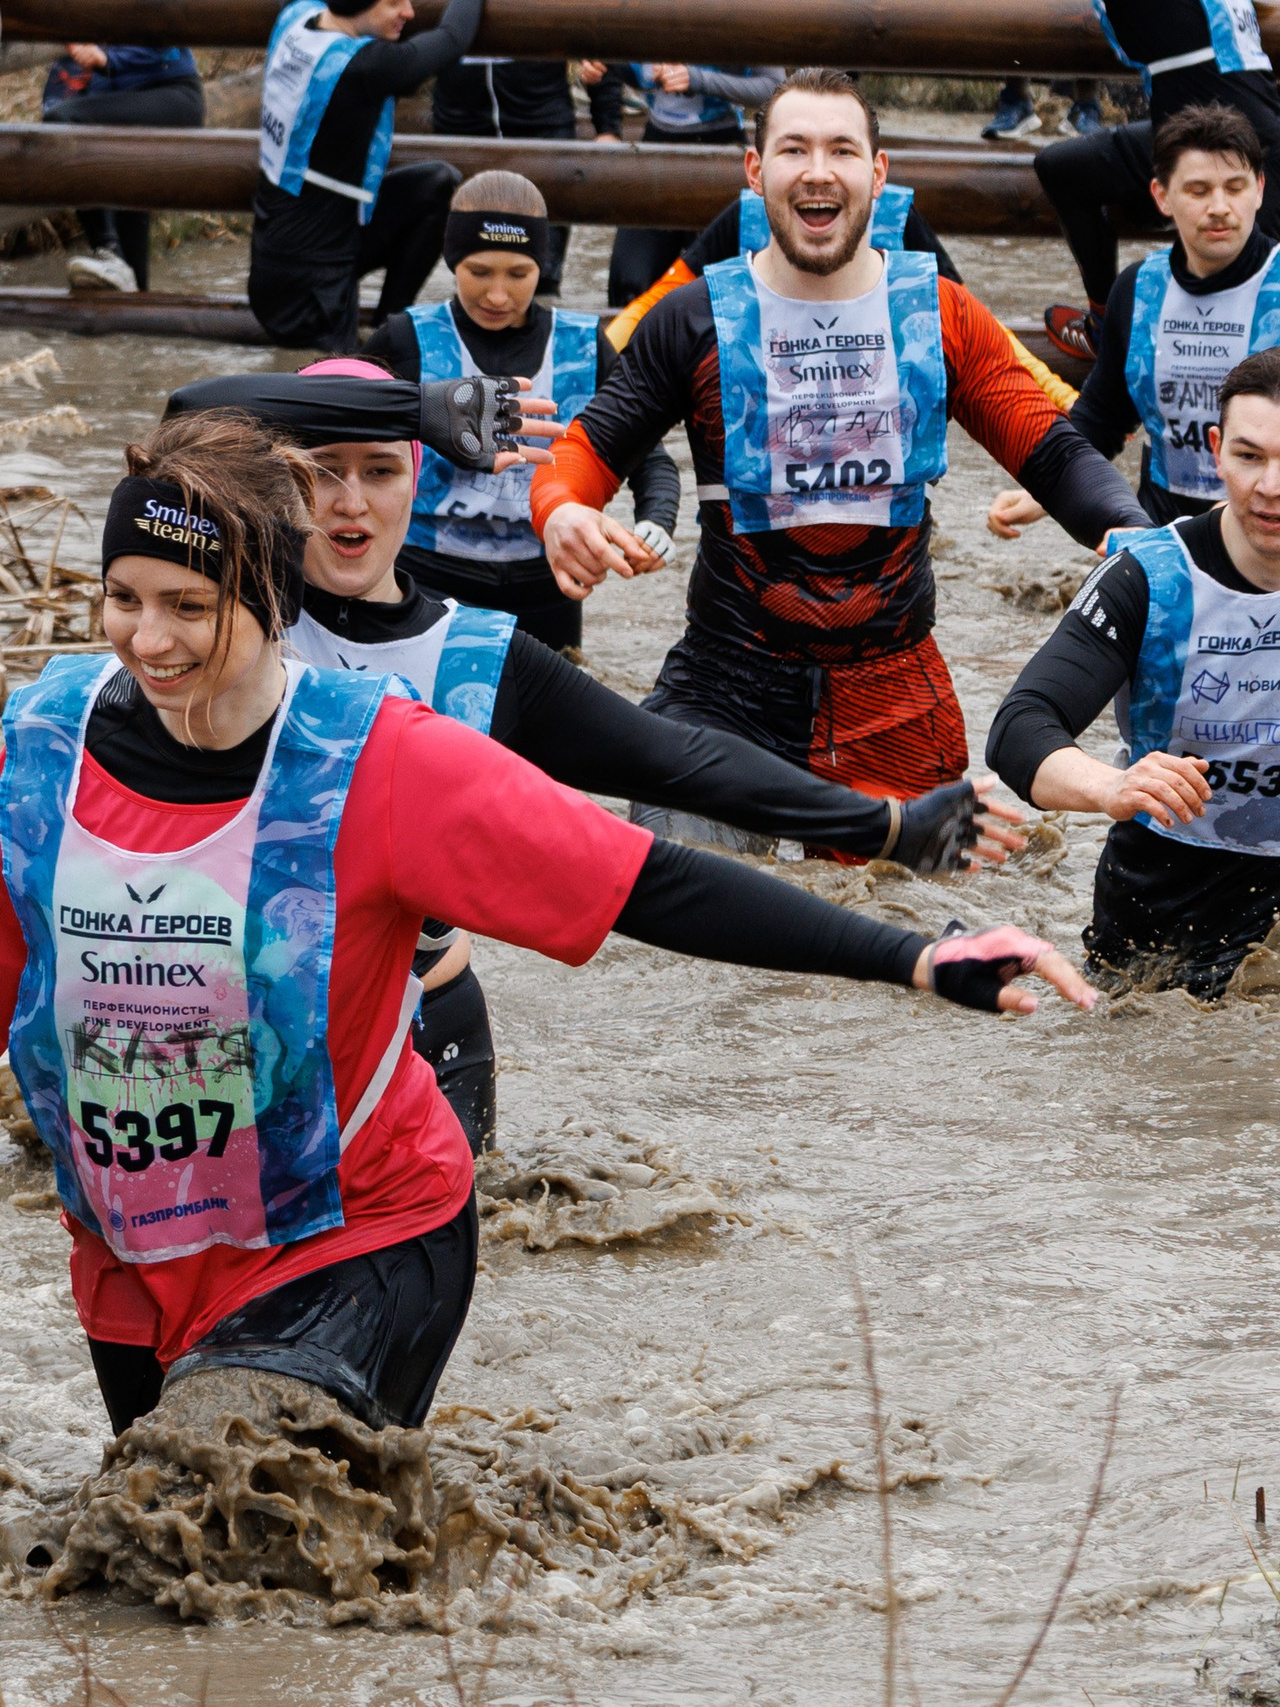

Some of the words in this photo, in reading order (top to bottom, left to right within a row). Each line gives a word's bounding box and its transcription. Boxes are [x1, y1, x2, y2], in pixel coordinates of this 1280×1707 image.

[483, 221, 526, 236] Sminex
[489, 232, 521, 243] team
[1163, 319, 1200, 331] ГОНКА
[1203, 321, 1245, 334] ГЕРОЕВ
[769, 338, 822, 353] ГОНКА
[826, 334, 885, 348] ГЕРОЕВ
[1172, 338, 1230, 358] Sminex
[789, 360, 872, 385] Sminex
[792, 390, 876, 400] ПЕРФЕКЦИОНИСТЫ
[792, 403, 812, 411] FINE
[815, 399, 876, 410] DEVELOPMENT
[785, 459, 892, 494] 5402
[144, 499, 220, 538] Sminex
[153, 518, 206, 550] team
[1198, 636, 1252, 650] ГОНКА
[1182, 751, 1280, 797] 653
[60, 905, 133, 933] ГОНКА
[140, 914, 232, 937] ГЕРОЕВ
[81, 950, 207, 987] Sminex
[83, 1000, 210, 1016] ПЕРФЕКЦИОНИСТЫ
[84, 1016, 112, 1028] FINE
[117, 1019, 210, 1033] DEVELOPMENT
[81, 1099, 235, 1173] 5397
[131, 1198, 229, 1228] ГАЗПРОМБАНК
